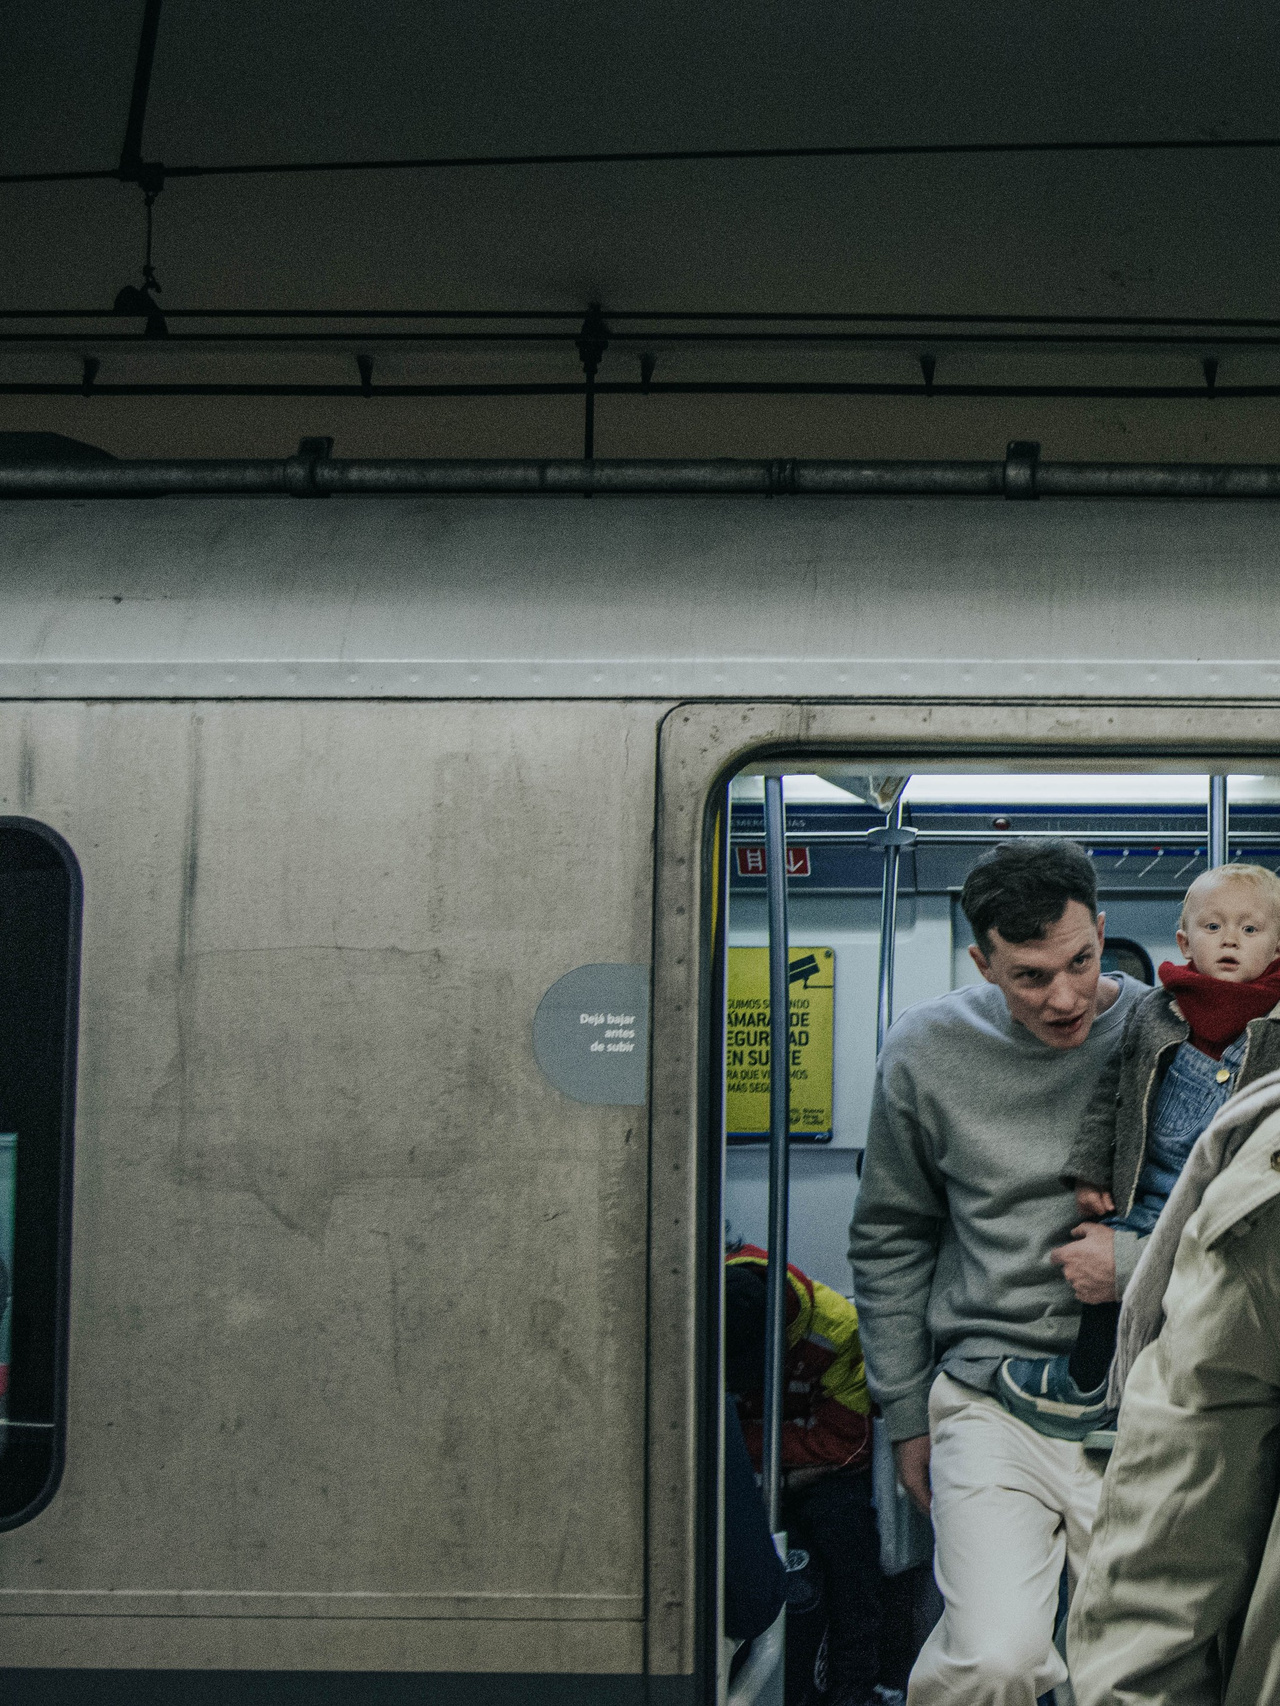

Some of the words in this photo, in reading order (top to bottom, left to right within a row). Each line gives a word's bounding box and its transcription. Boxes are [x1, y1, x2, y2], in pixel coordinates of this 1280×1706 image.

[727, 999, 761, 1009] GUIMOS
[580, 1013, 605, 1026] Dejá
[607, 1013, 636, 1026] bajar
[727, 1010, 770, 1027] ÁMAR
[790, 1012, 810, 1027] DE
[605, 1029, 635, 1038] antes
[726, 1030, 810, 1047] EGURAD
[590, 1041, 605, 1052] de
[606, 1041, 635, 1052] subir
[748, 1050, 802, 1066] SUE
[726, 1069, 738, 1079] RA
[740, 1069, 759, 1080] QUE
[760, 1069, 808, 1080] VIMOS
[727, 1080, 748, 1092] MÁS
